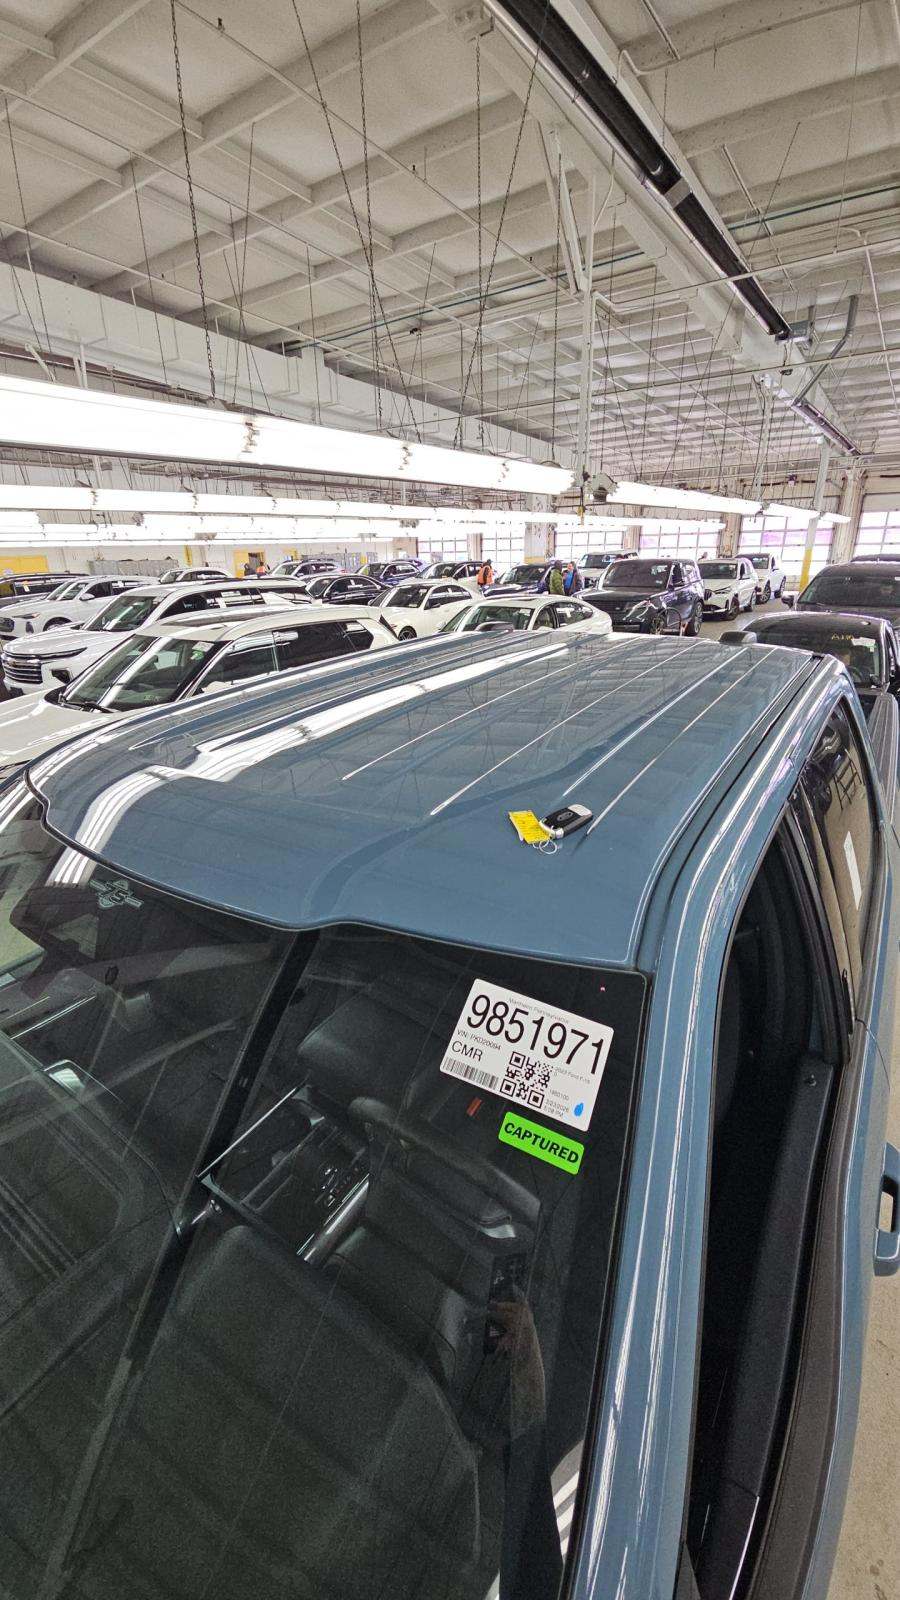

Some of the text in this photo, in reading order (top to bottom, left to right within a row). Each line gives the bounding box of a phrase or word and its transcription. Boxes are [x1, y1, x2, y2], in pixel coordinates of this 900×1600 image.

[451, 1040, 484, 1061] CMR
[466, 994, 604, 1075] 9851971
[504, 1122, 579, 1164] CAPTURED
